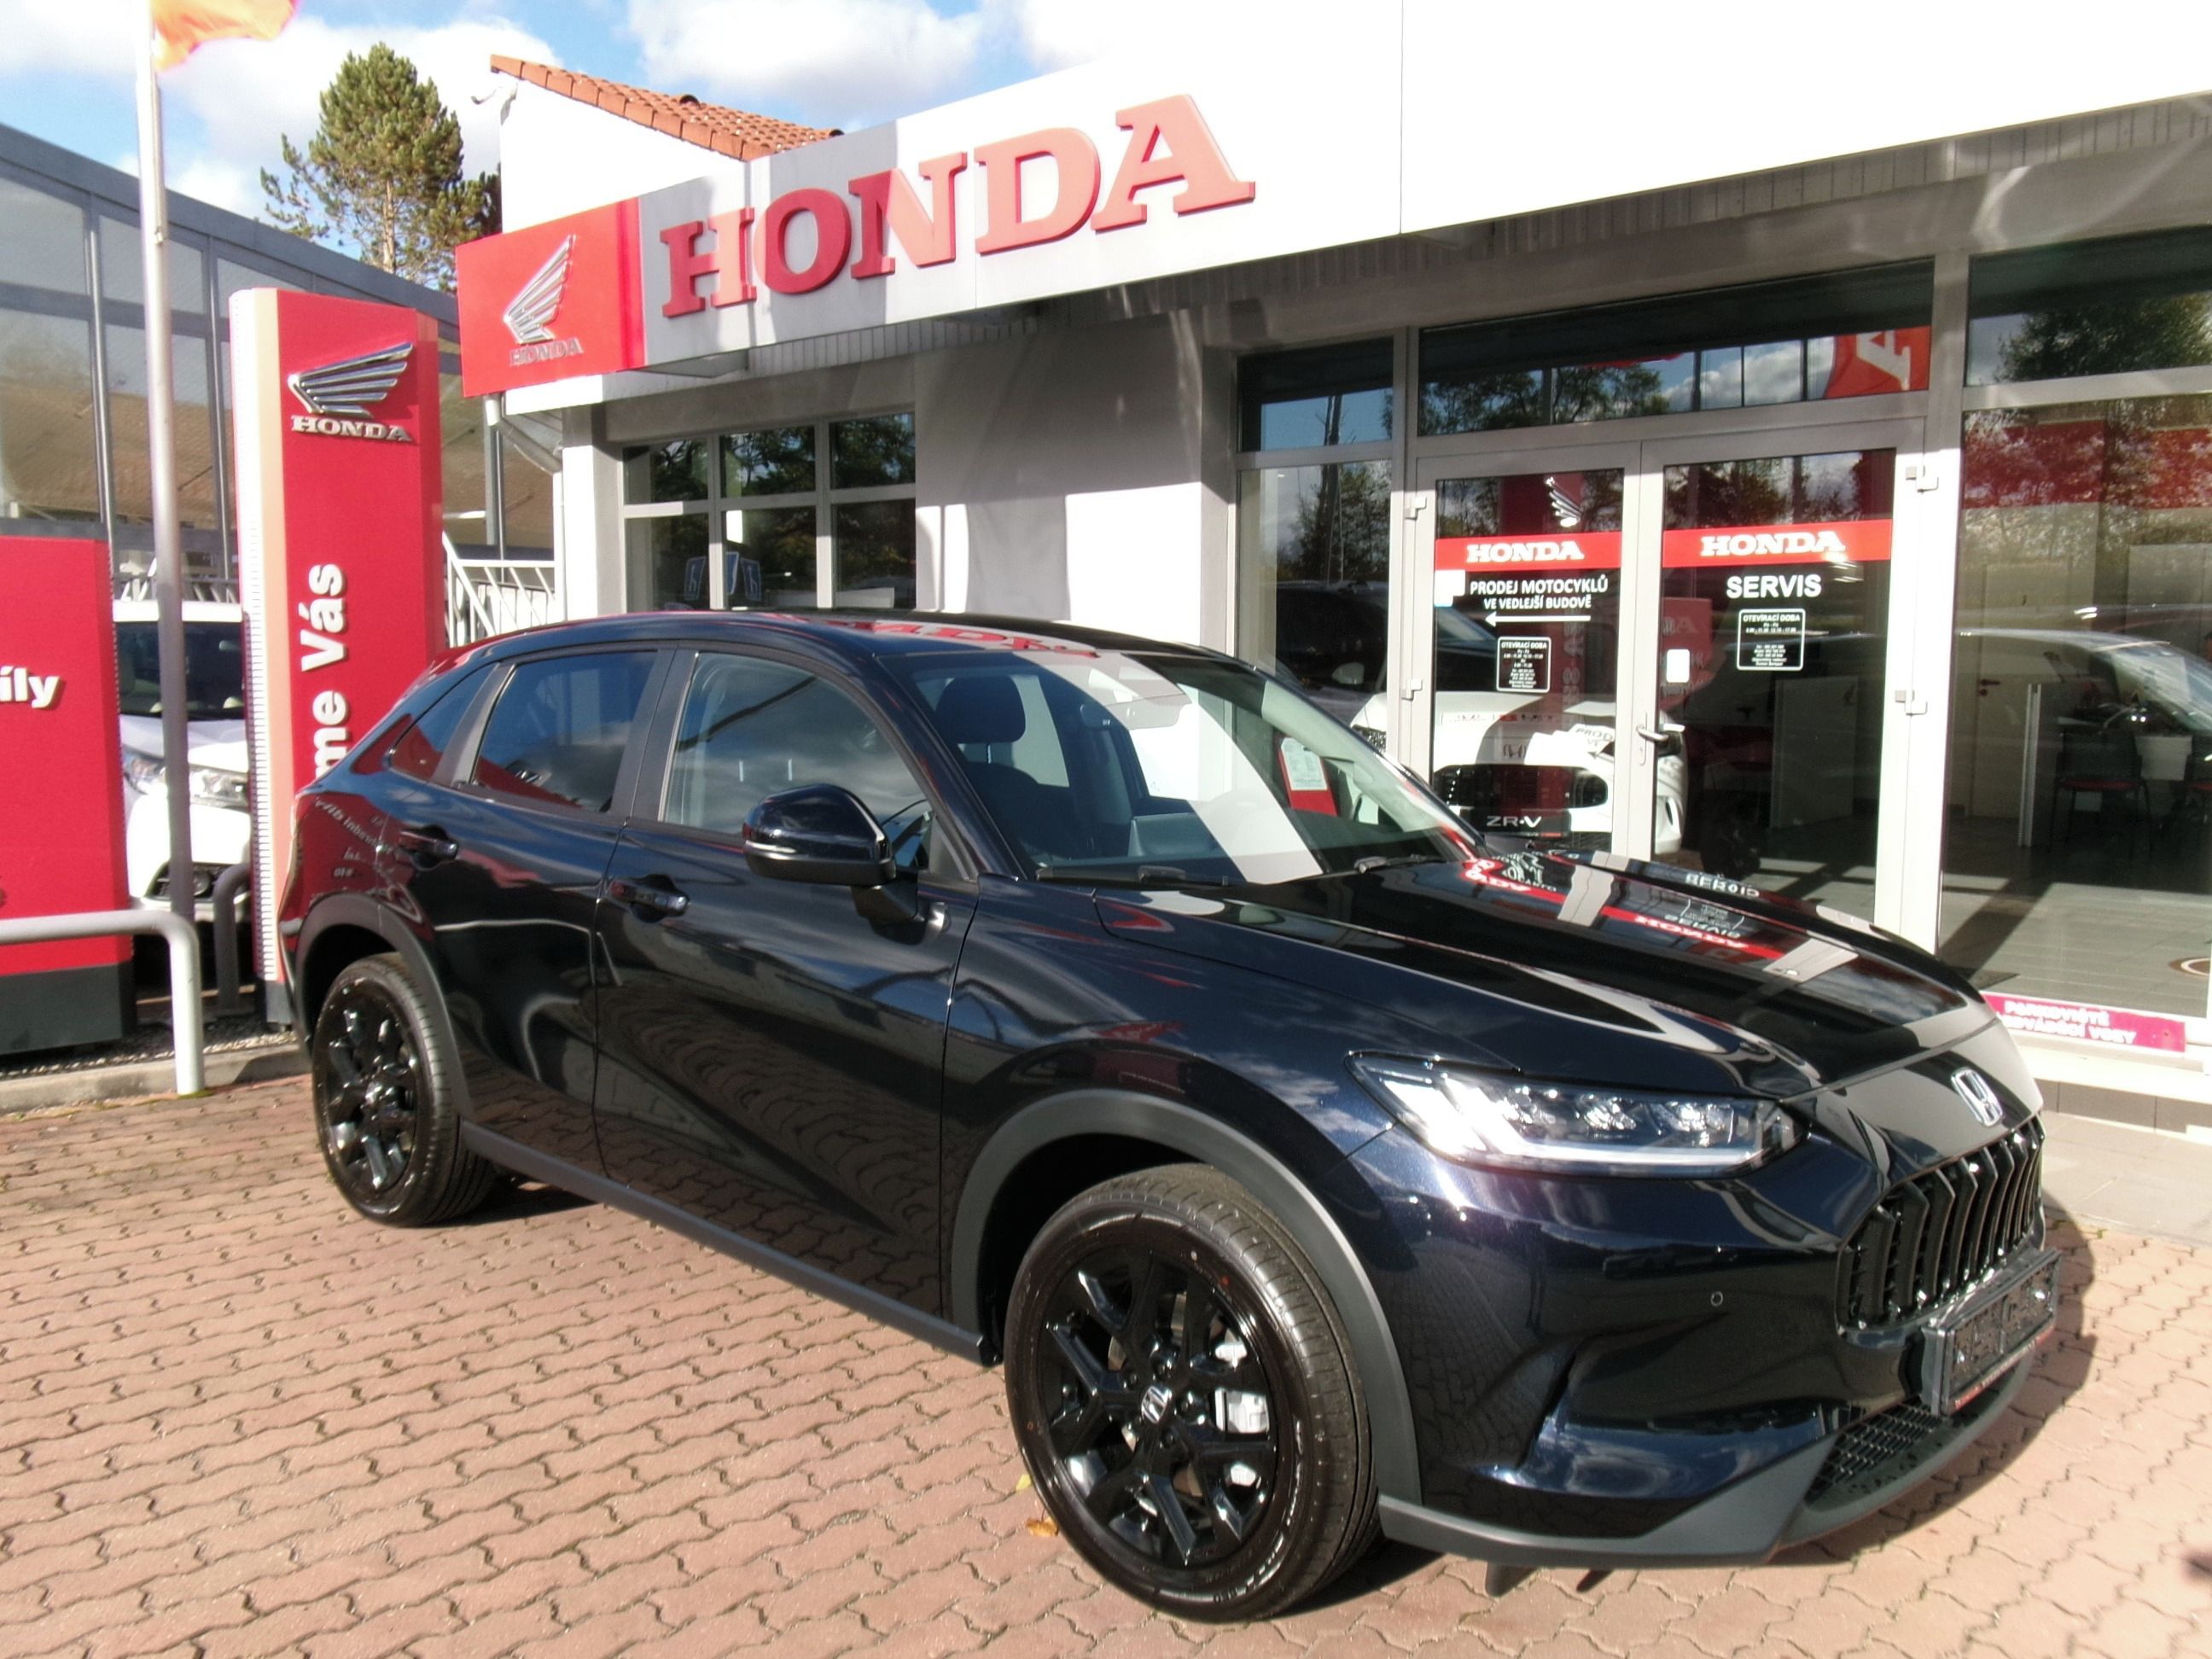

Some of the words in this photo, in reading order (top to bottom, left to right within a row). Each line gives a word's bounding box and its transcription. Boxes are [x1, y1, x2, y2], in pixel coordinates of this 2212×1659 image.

[660, 94, 1255, 317] HONDA
[509, 336, 585, 367] HONDA
[291, 415, 412, 442] HONDA
[1466, 540, 1586, 563] HONDA
[1701, 531, 1846, 556] HONDA
[1470, 580, 1518, 596] PRODEJ
[1521, 574, 1609, 595] MOTOCYKLŮ
[1726, 573, 1822, 599] SERVIS
[1483, 598, 1497, 609] VE
[1499, 595, 1544, 609] VEDLEJŠÍ
[1545, 594, 1592, 609] BUDOVĚ
[298, 564, 346, 672] Vás
